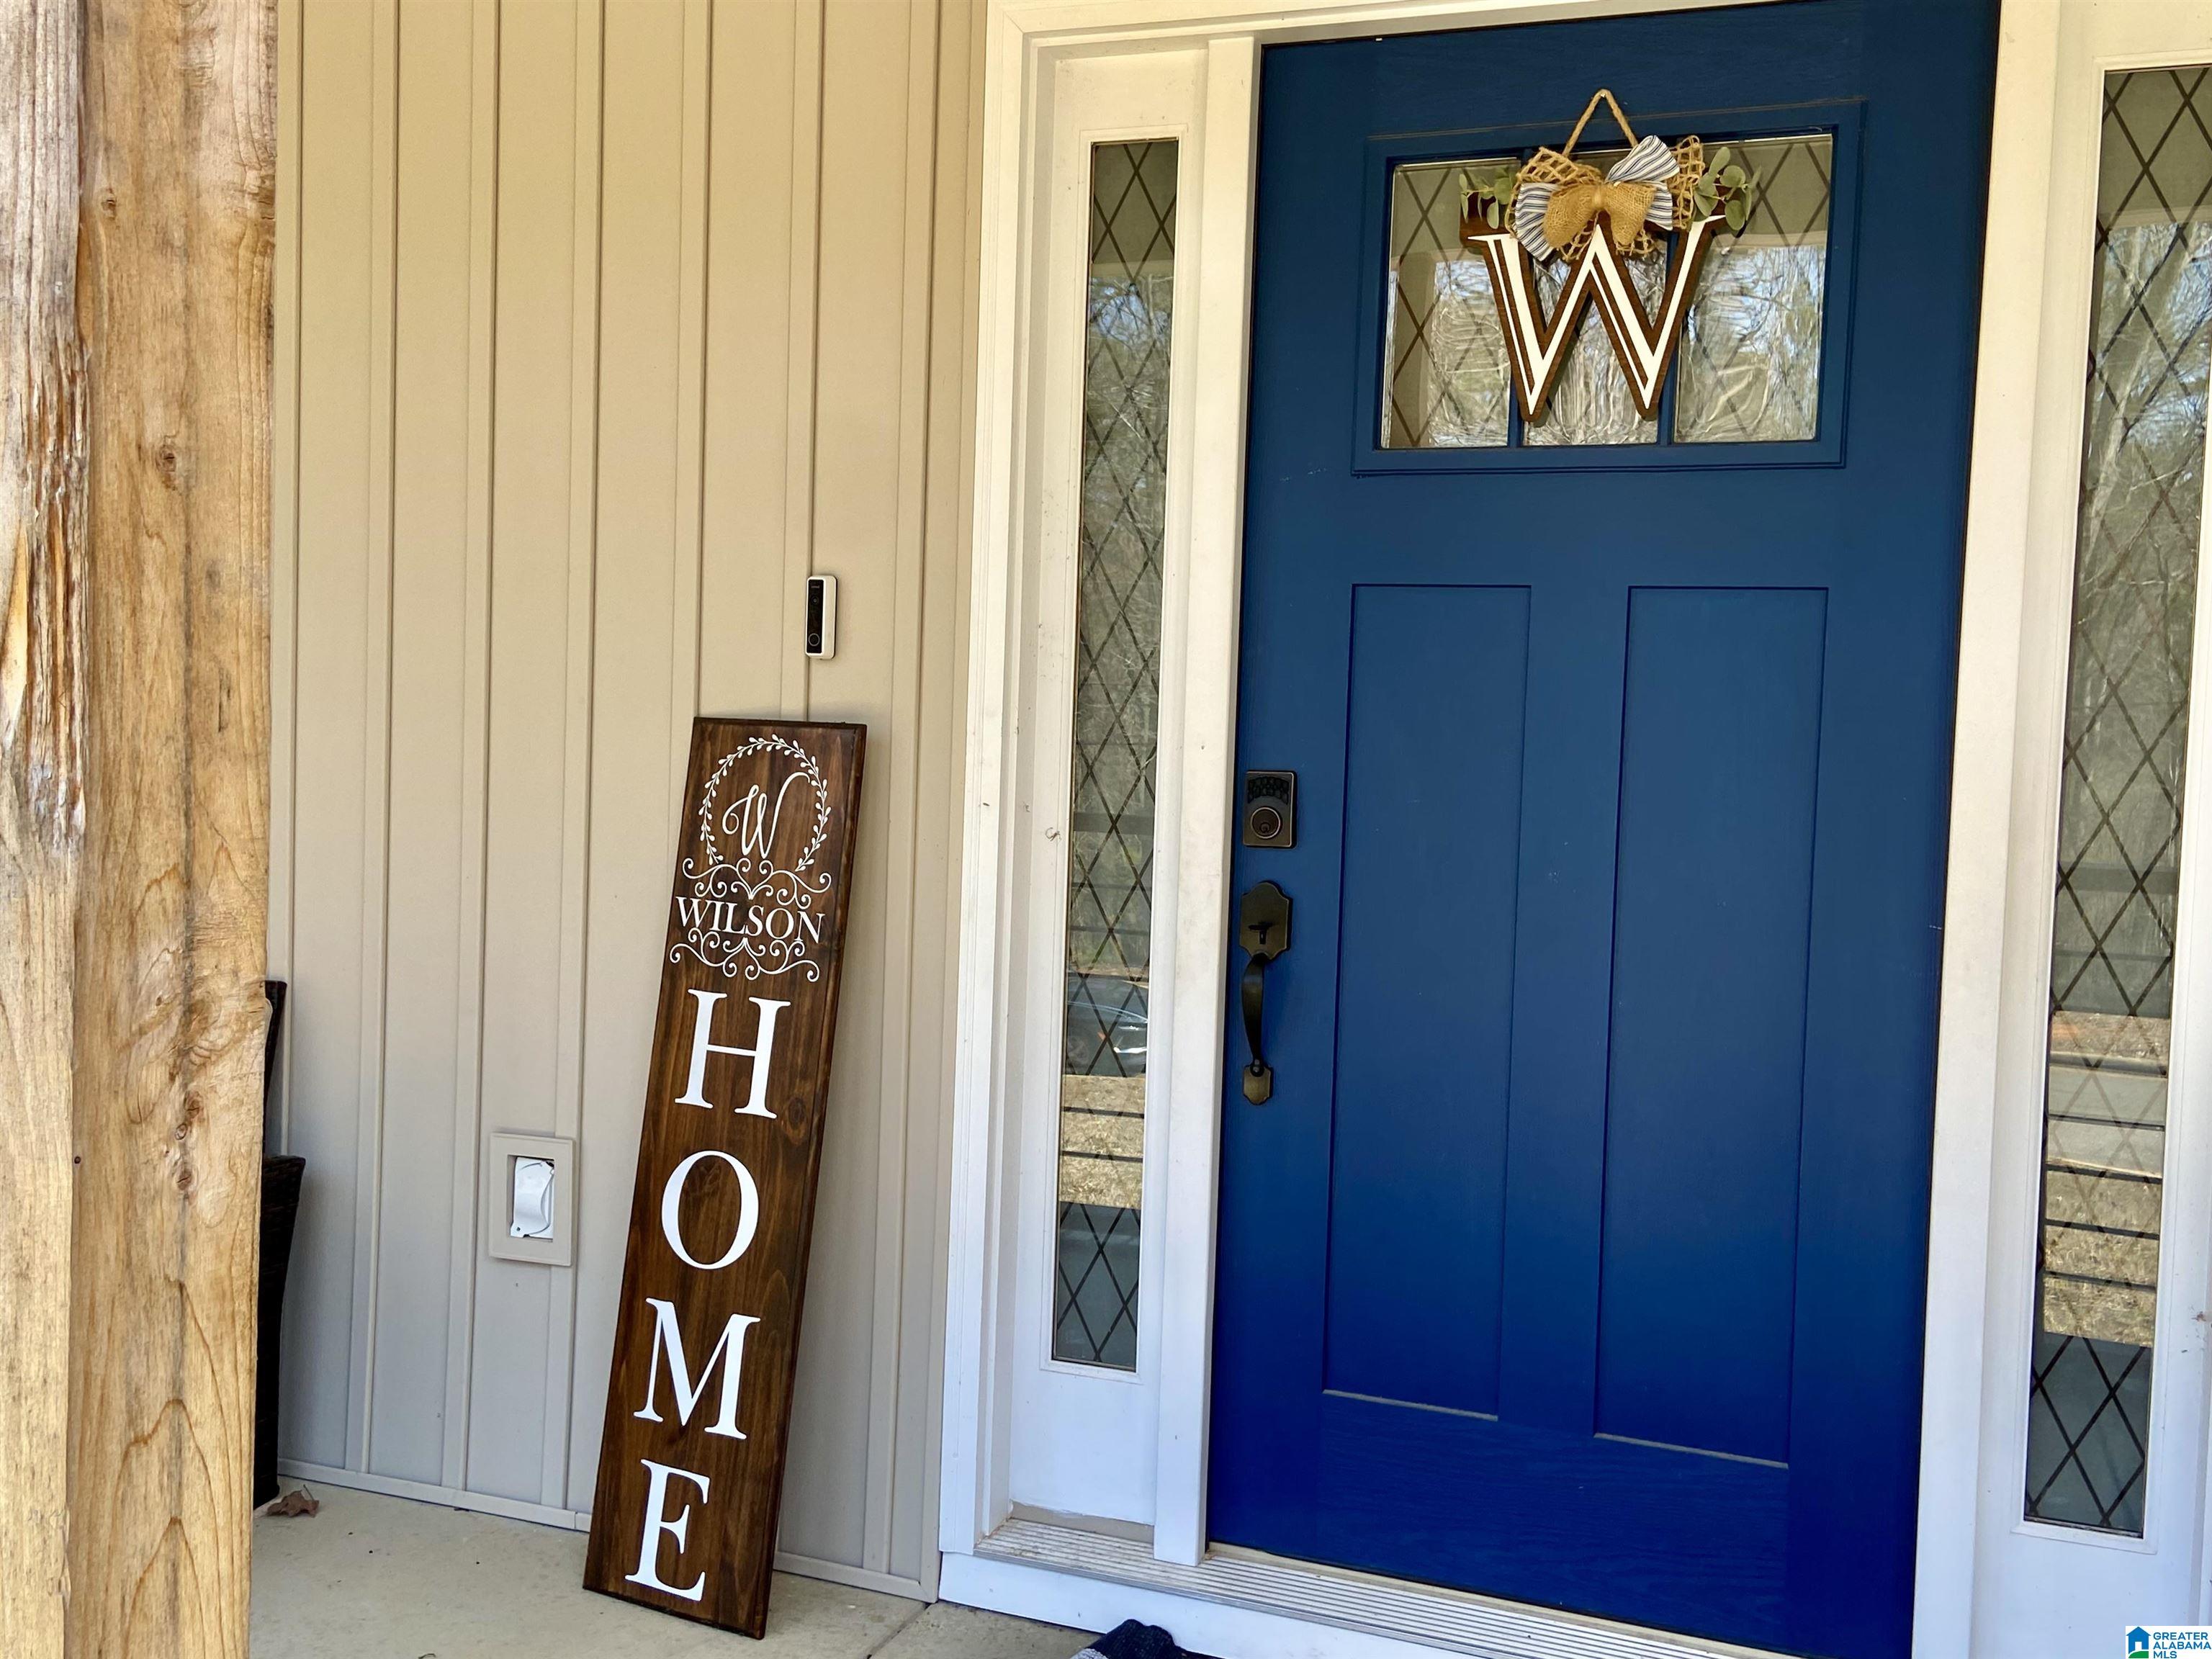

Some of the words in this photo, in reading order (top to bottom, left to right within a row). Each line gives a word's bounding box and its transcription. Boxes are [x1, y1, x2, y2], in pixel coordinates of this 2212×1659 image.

[1463, 204, 1731, 421] W
[722, 771, 810, 858] W
[675, 896, 826, 944] WILSON
[624, 988, 791, 1602] HOME
